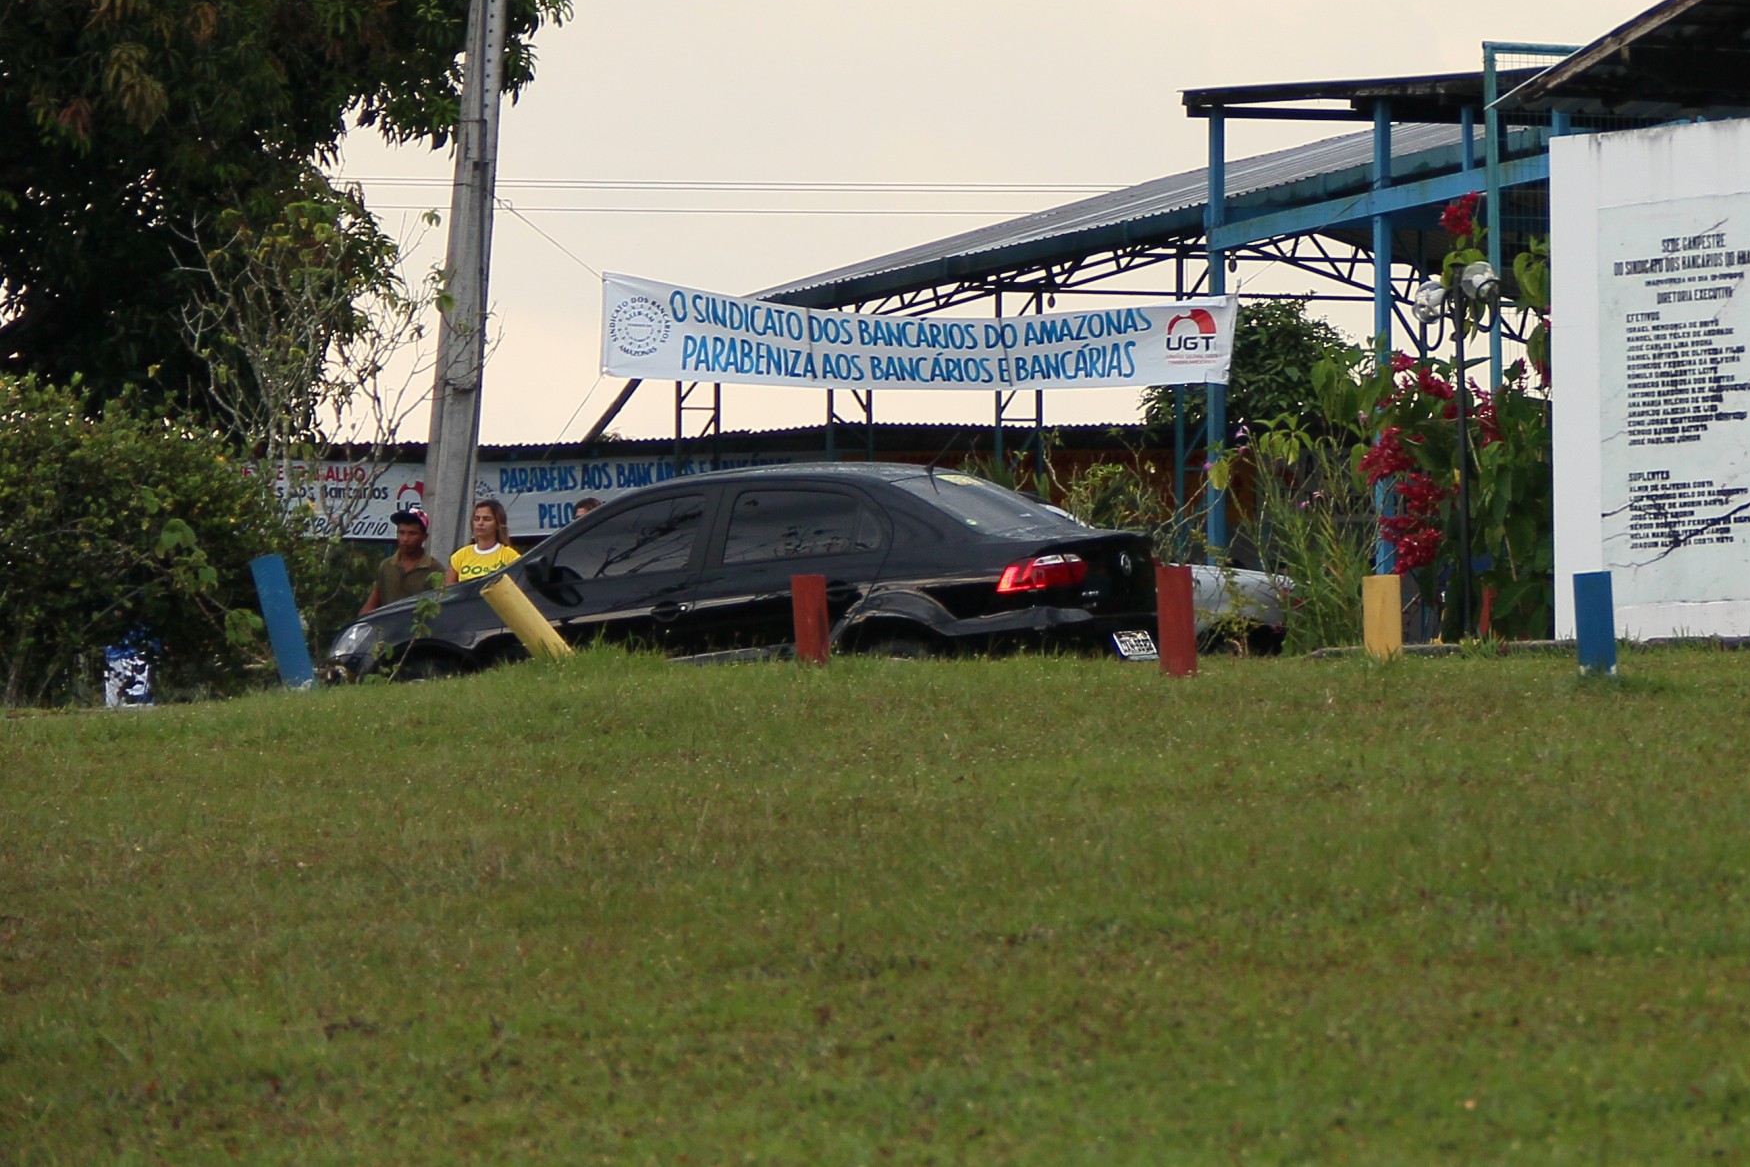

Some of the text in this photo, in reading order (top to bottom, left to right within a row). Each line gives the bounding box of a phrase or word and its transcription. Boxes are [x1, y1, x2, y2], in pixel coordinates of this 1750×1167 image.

[1682, 233, 1726, 250] CAMPESTRE
[609, 300, 629, 342] SINDICATO
[630, 296, 649, 304] DOS
[669, 290, 1152, 350] O SINDICATO DOS BANCÁRIOS DO AMAZONAS
[618, 344, 657, 357] AMAZONAS
[681, 334, 1136, 384] PARABENIZA AOS BANCÁRIOS E BANCÁRIAS
[1166, 334, 1216, 352] UGT
[499, 460, 578, 494] PARABÉNS
[580, 461, 613, 490] AOS
[615, 455, 696, 488] BANCÁROS
